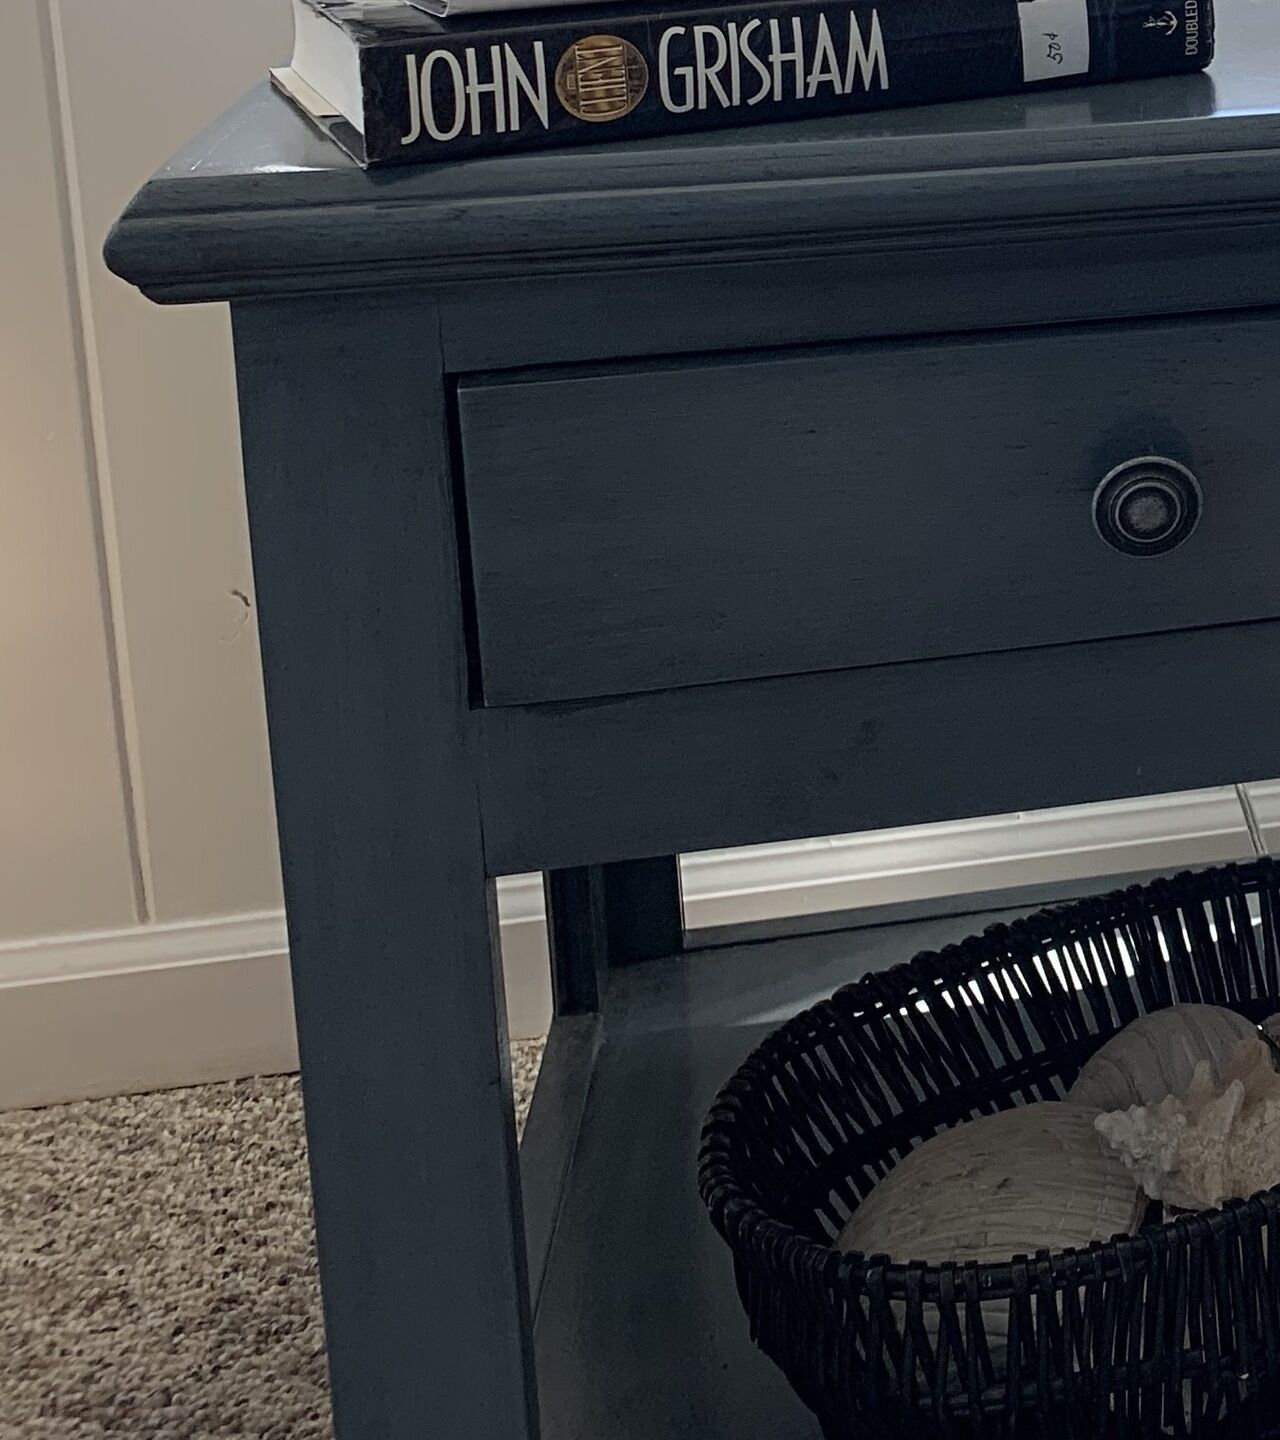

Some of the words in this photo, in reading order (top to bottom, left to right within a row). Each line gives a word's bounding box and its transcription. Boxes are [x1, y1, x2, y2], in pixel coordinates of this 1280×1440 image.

[401, 41, 550, 145] JOHN
[658, 8, 890, 114] GRISHAM
[575, 44, 629, 117] CLIENT
